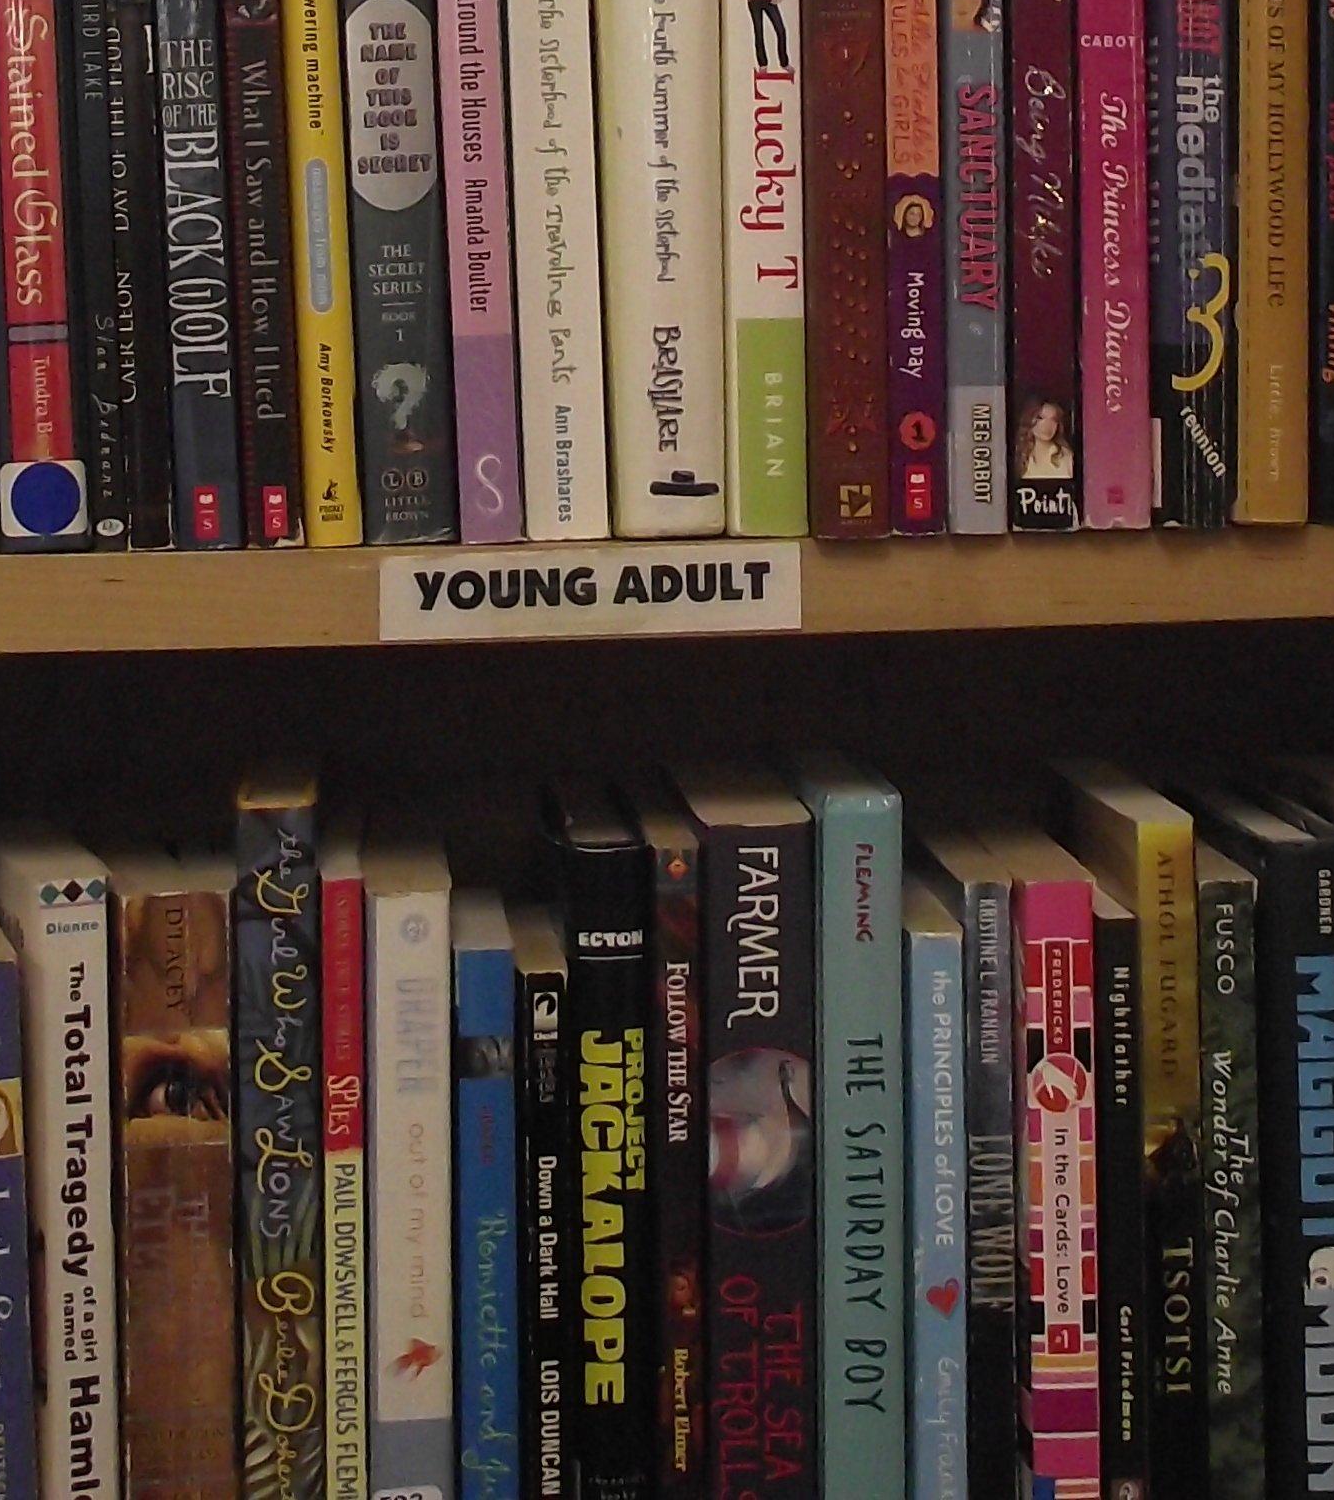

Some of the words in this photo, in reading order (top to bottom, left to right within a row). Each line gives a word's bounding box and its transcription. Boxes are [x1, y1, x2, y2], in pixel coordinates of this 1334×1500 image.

[1080, 34, 1136, 48] CABOT
[366, 87, 412, 106] THIS
[460, 61, 486, 92] the
[1203, 74, 1224, 123] the
[363, 108, 417, 127] BOOK
[379, 133, 400, 151] IS
[461, 97, 488, 164] Houses
[1099, 92, 1127, 148] The
[358, 153, 432, 175] SECRET
[740, 68, 797, 231] Lucky
[164, 129, 224, 270] BLACK
[465, 179, 490, 247] Amanda
[956, 81, 1000, 311] SANCTUARY
[1101, 161, 1128, 287] Princess
[469, 251, 493, 313] Boulter
[757, 255, 799, 289] T
[167, 276, 232, 399] WOLF
[1102, 300, 1131, 414] Diaries
[764, 371, 784, 478] BRIAN
[972, 404, 992, 442] MEG
[1179, 405, 1229, 478] reunion
[972, 447, 992, 503] CABOT
[413, 566, 598, 610] YOUNG
[613, 561, 770, 603] ADULT
[854, 843, 874, 942] FLEMING
[726, 846, 779, 1029] FARMER
[1216, 902, 1235, 995] FUSCO
[68, 962, 85, 1002] The
[665, 962, 690, 1044] FOLLOW
[1051, 948, 1064, 1046] FREDERICKS
[64, 1004, 92, 1105] Total
[845, 1033, 885, 1097] THE
[1109, 966, 1131, 1106] Nightfather
[668, 1049, 688, 1088] THE
[622, 1026, 646, 1191] PROJECT
[667, 1092, 693, 1143] STAR
[1210, 1049, 1238, 1161] Wonder
[1055, 1128, 1069, 1146] In
[1229, 1134, 1256, 1185] The
[61, 1113, 95, 1278] Tragedy
[537, 1156, 559, 1210] Down
[1055, 1153, 1069, 1186] the
[1205, 1170, 1240, 1209] of
[538, 1215, 556, 1227] a
[578, 1029, 627, 1405] JACKALOPE
[843, 1123, 887, 1313] SATURDAY
[1055, 1194, 1072, 1258] Cards:
[539, 1232, 559, 1278] Dark
[1215, 1209, 1240, 1309] Charlie
[83, 1286, 97, 1306] of
[83, 1311, 95, 1322] a
[539, 1283, 559, 1319] Hall
[1056, 1265, 1072, 1314] Love
[63, 1292, 78, 1362] named
[81, 1328, 98, 1362] girl
[1119, 1306, 1133, 1343] Carl
[540, 1359, 561, 1405] LOIS
[672, 1349, 689, 1411] Robert
[843, 1338, 887, 1413] BOY
[1215, 1317, 1238, 1395] Anne
[1119, 1350, 1133, 1442] Friedman
[540, 1410, 562, 1496] DUNCAN
[674, 1416, 691, 1473] Elmer
